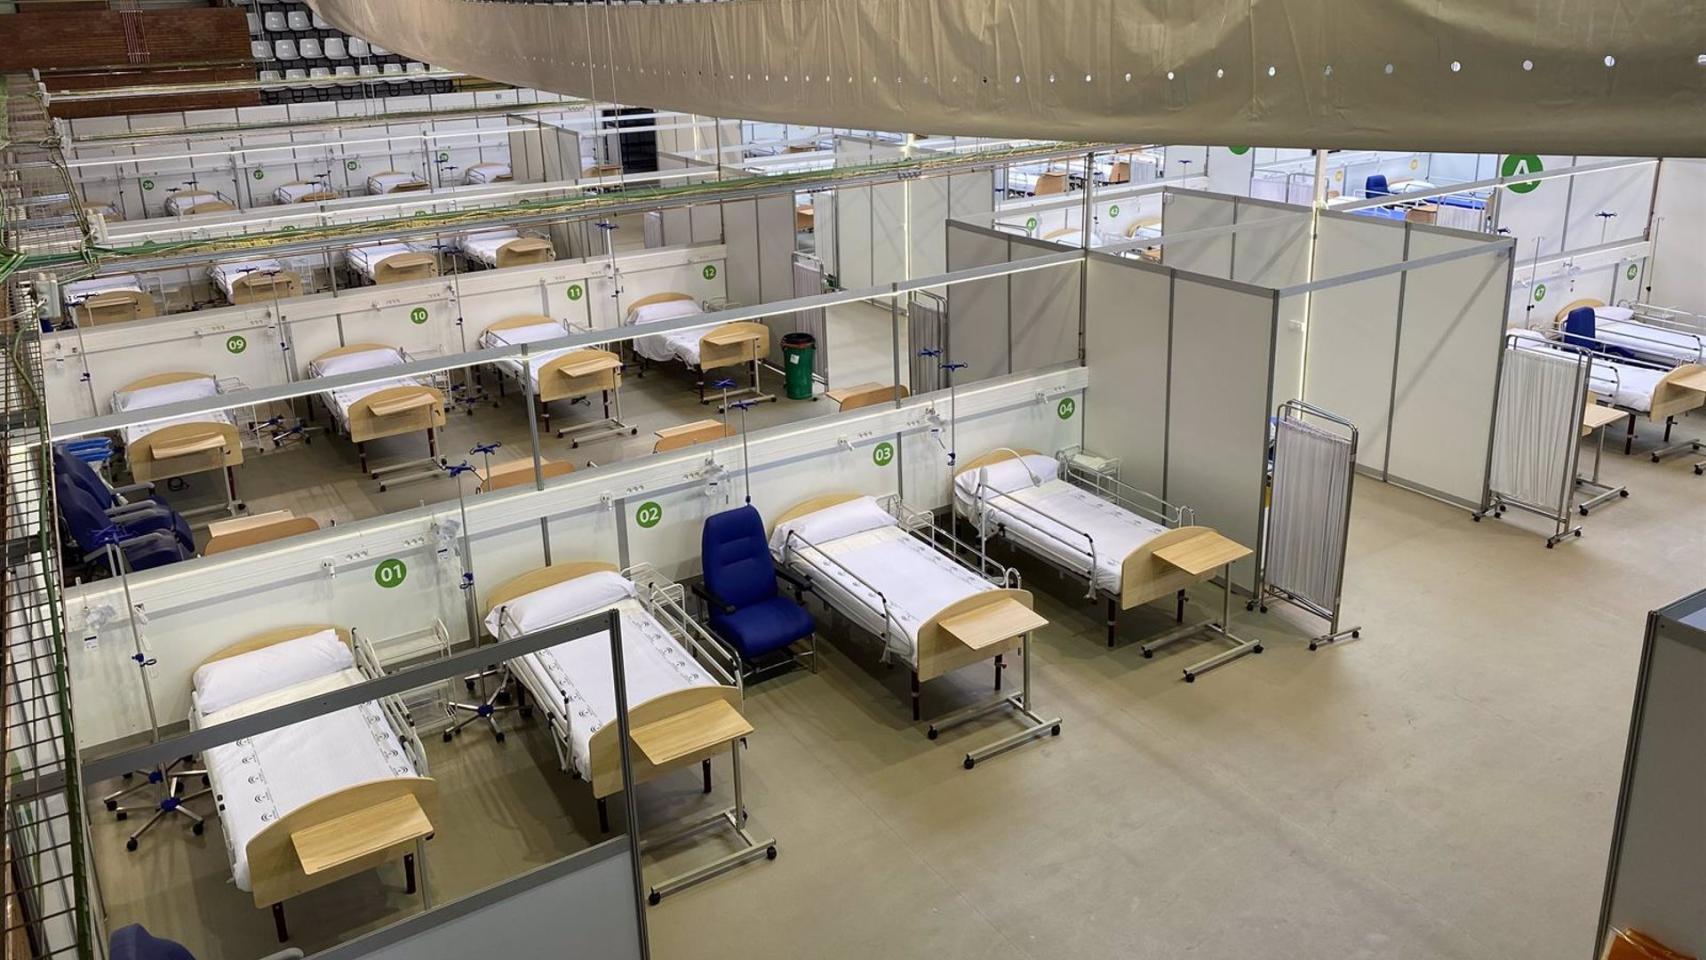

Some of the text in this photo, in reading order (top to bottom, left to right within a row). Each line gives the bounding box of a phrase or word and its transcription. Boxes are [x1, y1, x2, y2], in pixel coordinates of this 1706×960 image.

[705, 268, 714, 277] 12
[569, 287, 580, 297] 11
[413, 310, 426, 321] 10
[229, 339, 244, 350] 09
[1059, 402, 1074, 415] 04
[875, 448, 891, 461] 03
[639, 507, 659, 523] 02
[380, 564, 402, 582] 01
